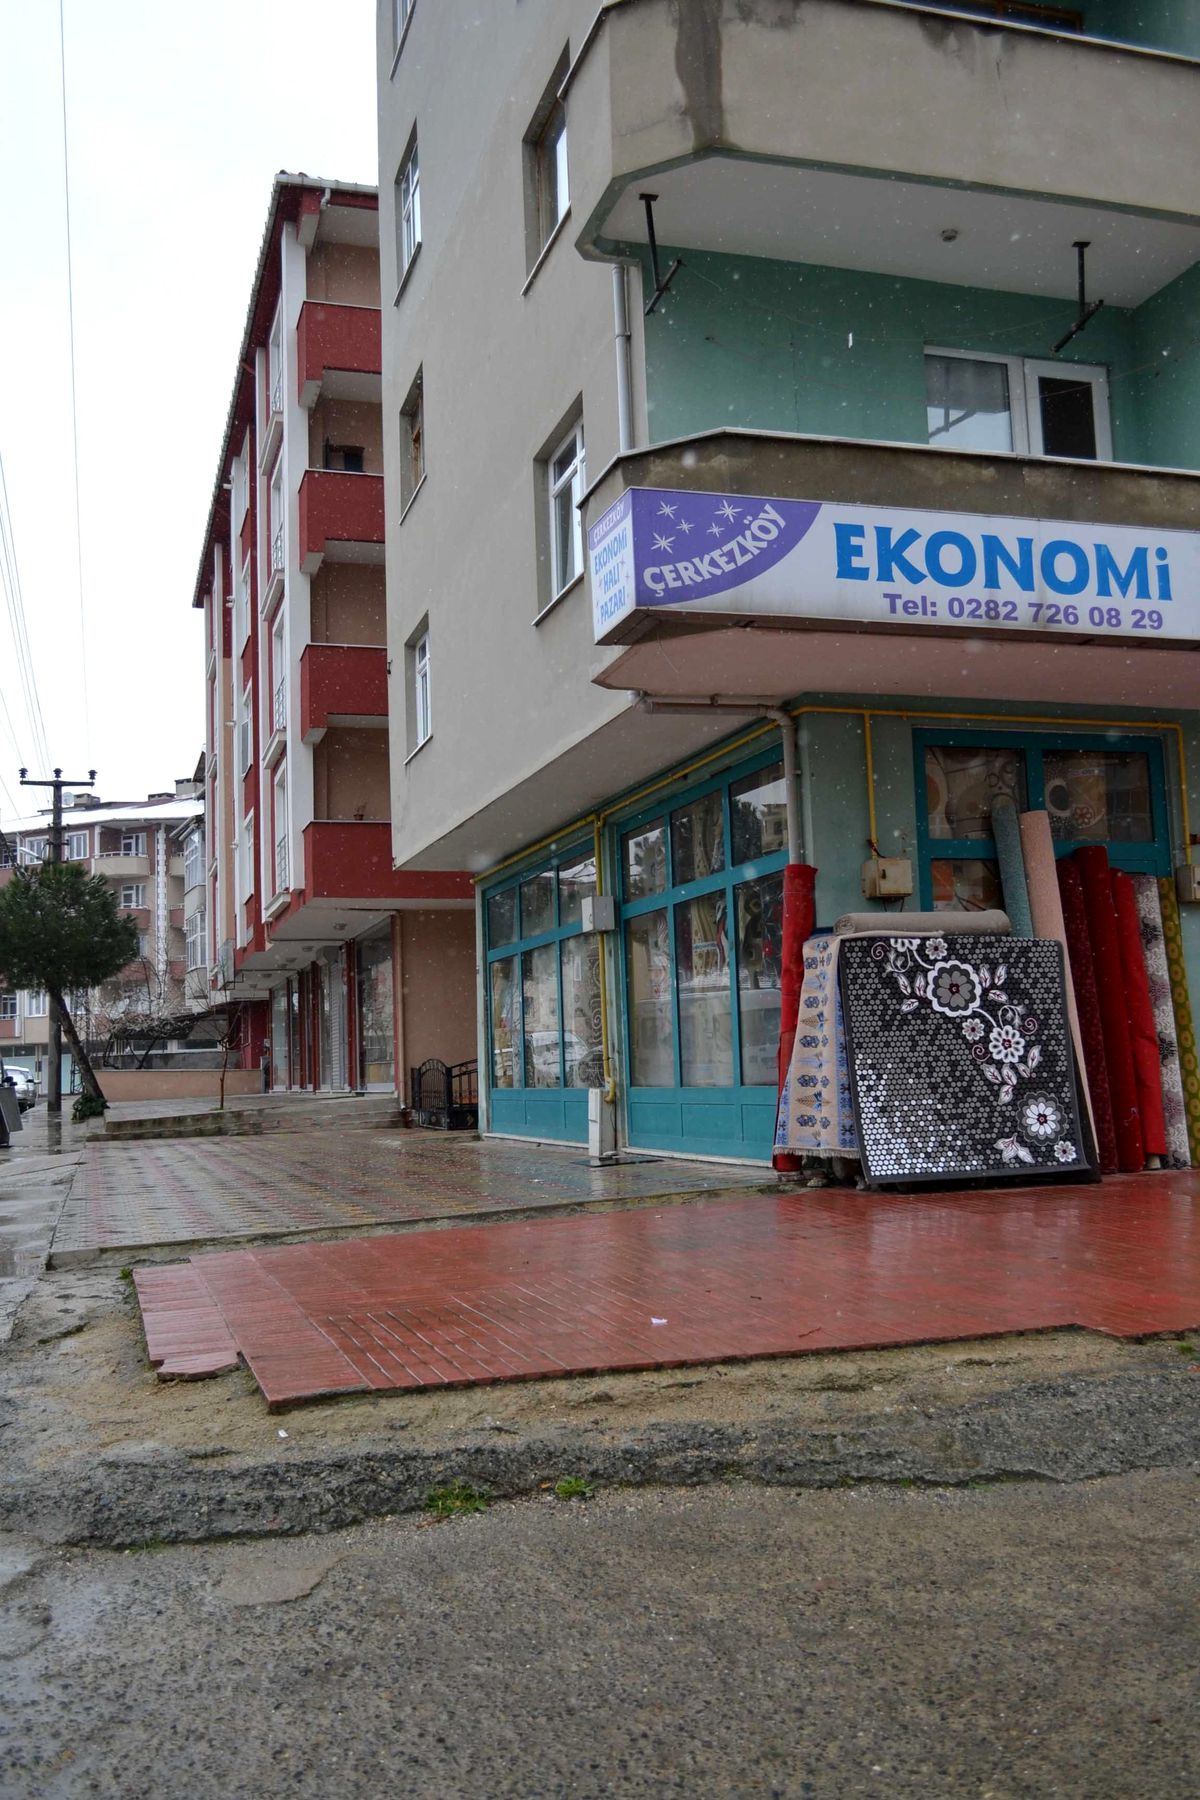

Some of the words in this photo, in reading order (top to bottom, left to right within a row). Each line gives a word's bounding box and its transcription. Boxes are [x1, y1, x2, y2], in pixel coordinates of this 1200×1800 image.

[643, 503, 786, 597] ÇERKEZKÖY
[600, 586, 626, 624] PAZARI
[883, 593, 937, 617] Tel:
[948, 597, 1018, 621] 0282
[1028, 602, 1079, 625] 726
[1088, 606, 1122, 628] 08
[1131, 609, 1163, 630] 29
